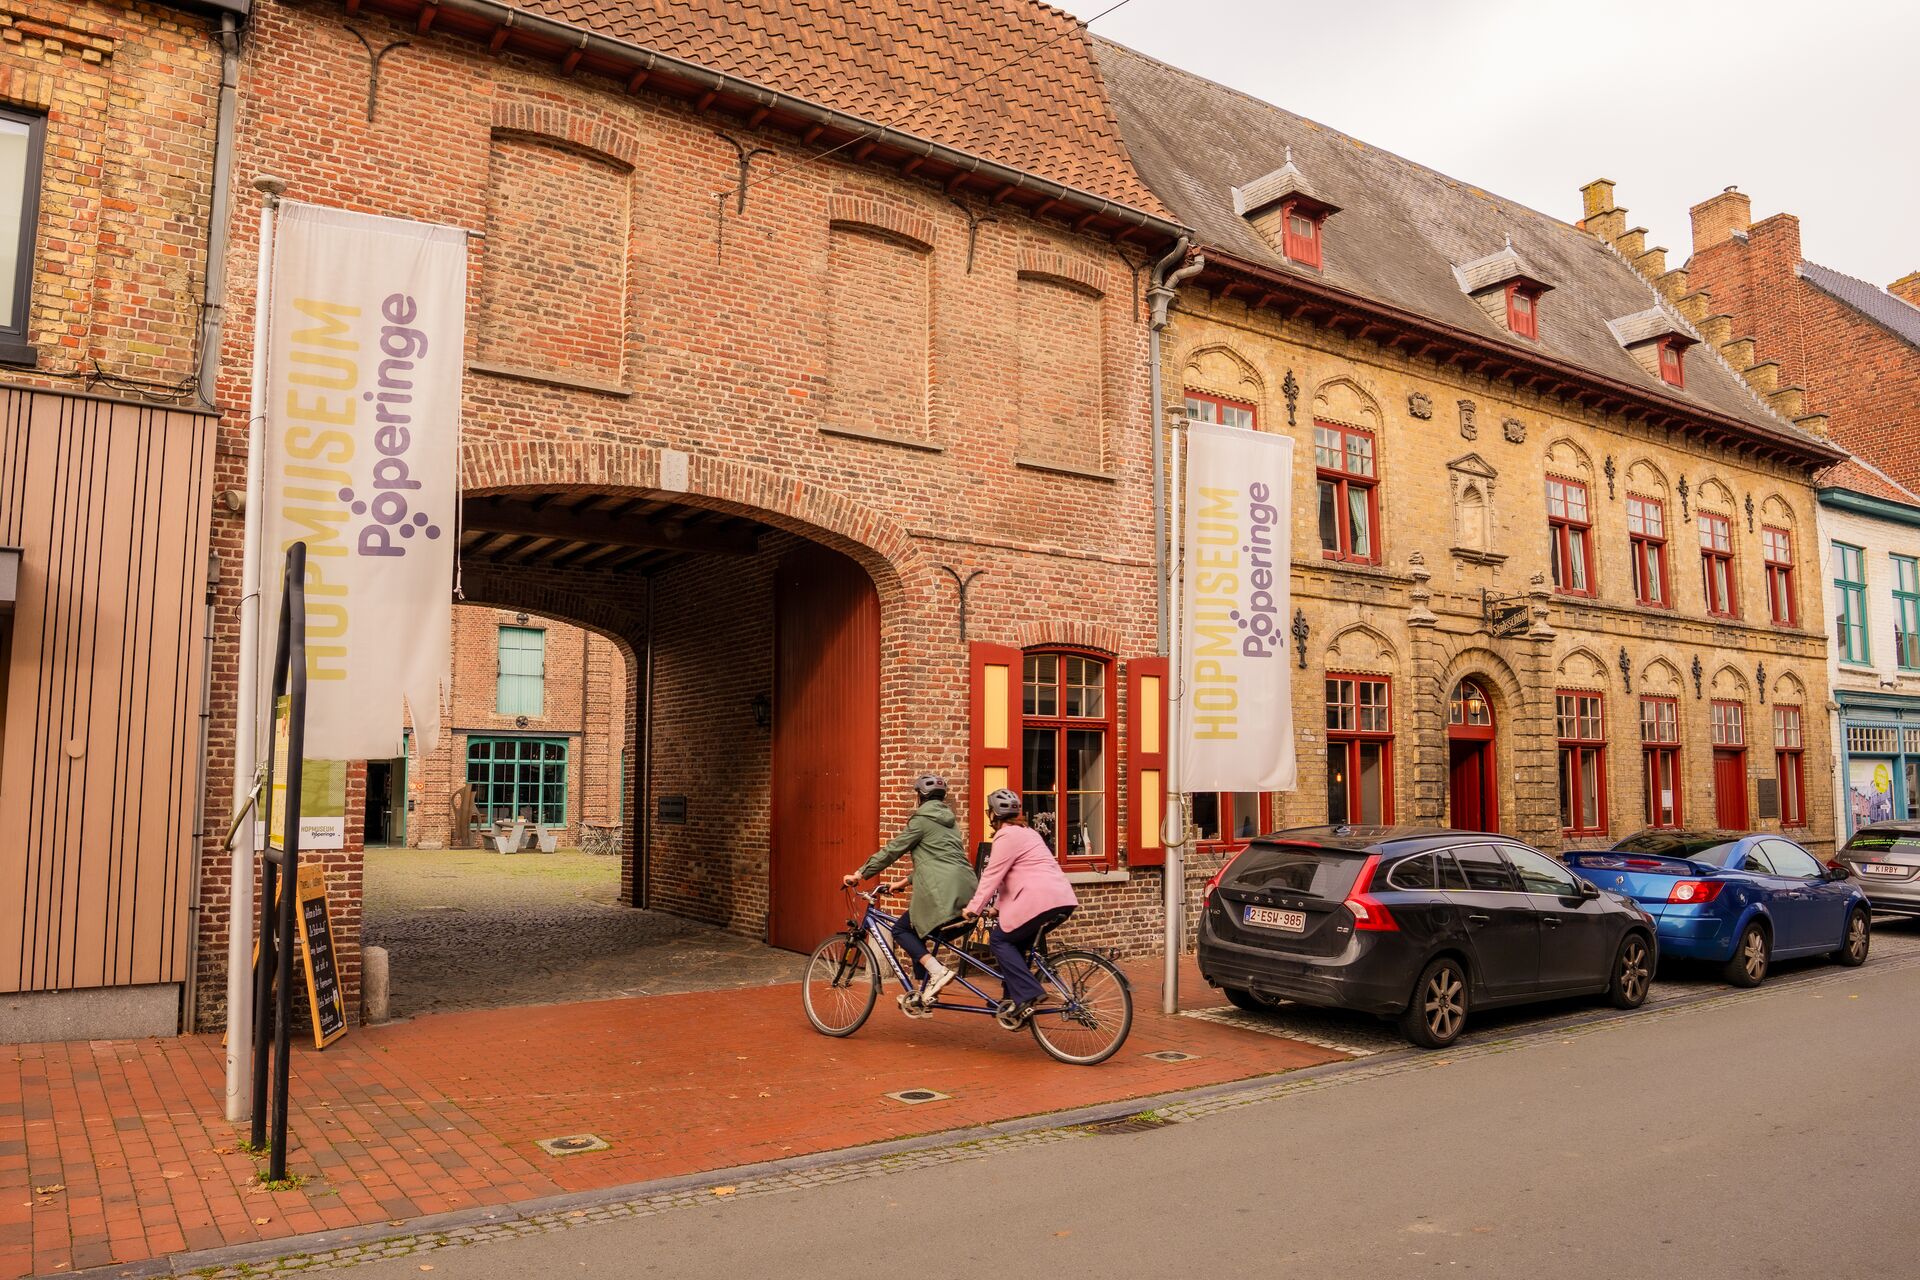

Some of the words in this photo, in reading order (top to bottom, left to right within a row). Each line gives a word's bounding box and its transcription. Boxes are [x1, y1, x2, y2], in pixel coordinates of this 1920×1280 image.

[279, 298, 361, 681] HOPMUSEUM
[358, 293, 429, 557] Poperinge
[1194, 486, 1239, 740] HOPMUSEUM
[1243, 481, 1278, 658] Poperinge
[1240, 893, 1304, 908] VOLVO
[1875, 865, 1898, 874] KIRBY
